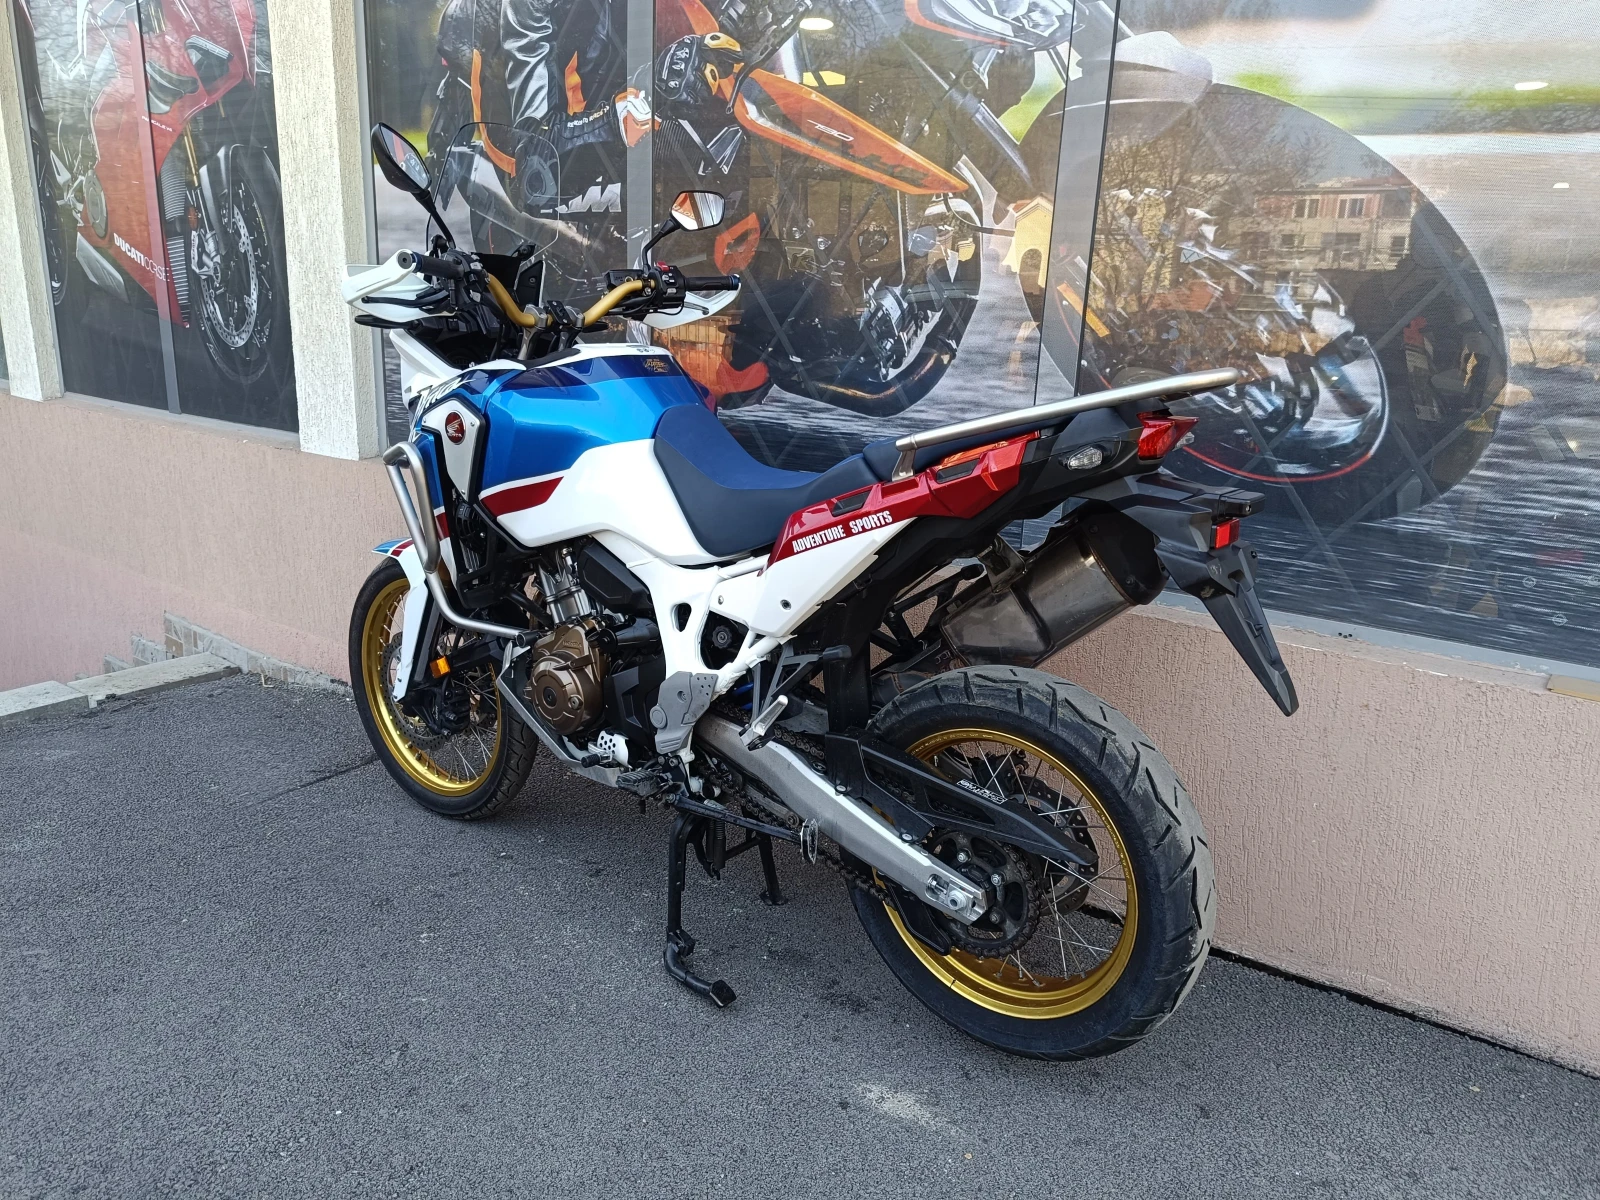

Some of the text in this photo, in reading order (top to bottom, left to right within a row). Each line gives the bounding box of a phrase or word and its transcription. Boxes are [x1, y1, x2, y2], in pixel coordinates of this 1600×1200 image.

[113, 232, 144, 267] DUCATI
[792, 510, 893, 553] ADVENTURE SPORTS
